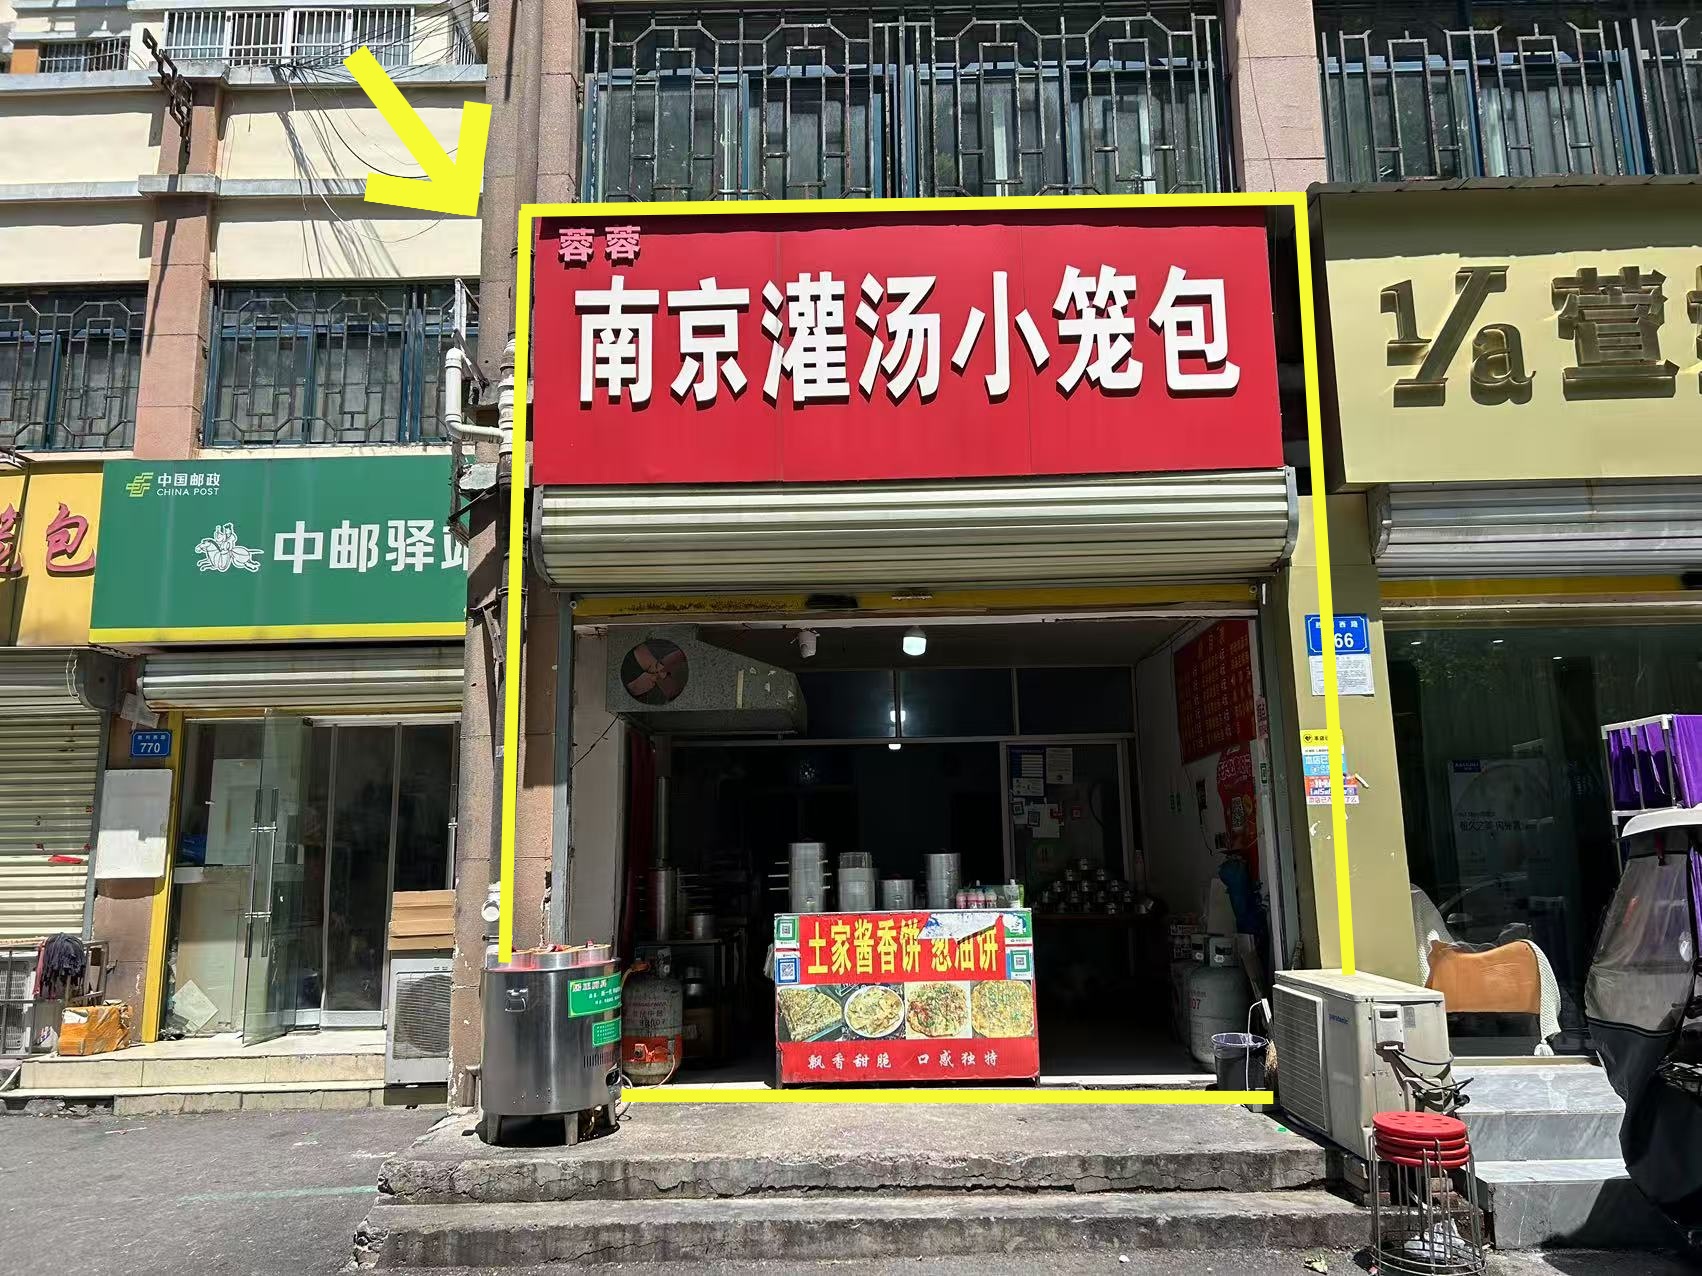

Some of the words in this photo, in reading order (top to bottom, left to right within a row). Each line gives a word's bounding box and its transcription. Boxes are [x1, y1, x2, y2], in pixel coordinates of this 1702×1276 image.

[558, 225, 641, 265] 蓉蓉
[574, 264, 1242, 405] 南京灌汤小笼包
[1550, 264, 1702, 402] 萱
[156, 488, 190, 496] CHINA
[194, 487, 220, 496] POST
[157, 472, 221, 487] 中国邮政
[140, 742, 161, 753] 770
[807, 917, 922, 975] 土家酱香饼
[917, 1049, 999, 1068] 口感独特
